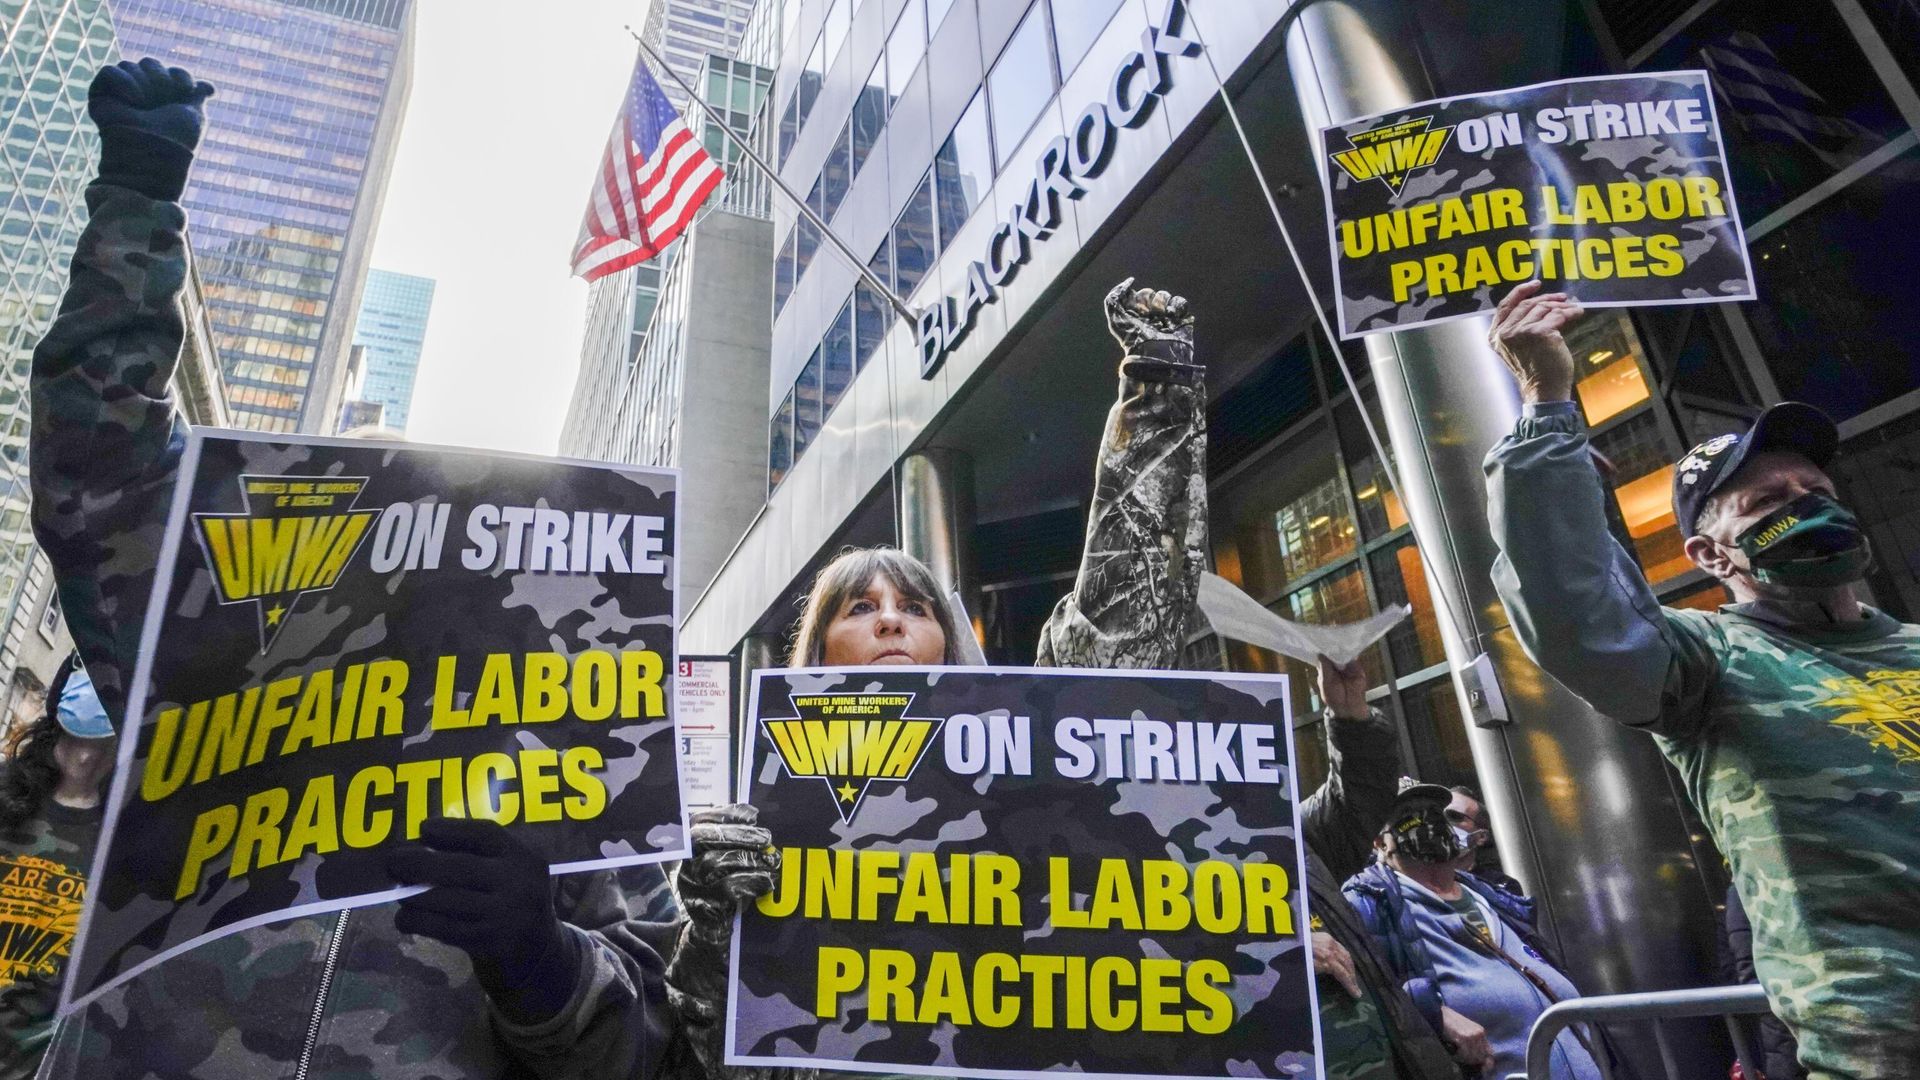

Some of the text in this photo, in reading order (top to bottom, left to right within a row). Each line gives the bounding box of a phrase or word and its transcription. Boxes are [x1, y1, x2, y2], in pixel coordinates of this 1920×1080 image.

[1335, 128, 1448, 180] UMWA
[1457, 99, 1707, 153] ON STRIKE
[916, 0, 1208, 381] BLACKROCK
[1341, 176, 1726, 259] UNFAIR LABOR
[1390, 234, 1685, 303] PRACTICES
[203, 513, 373, 600] UMWA
[370, 502, 665, 574] ON STRIKE
[1755, 515, 1799, 547] UMWA
[143, 649, 665, 802] UNFAIR LABOR
[796, 697, 908, 706] UNITED MINE WORKERS
[822, 705, 880, 714] OF AMERICA
[768, 719, 932, 777] UMWA
[944, 713, 1280, 784] ON STRIKE
[175, 745, 607, 900] PRACTICES
[2, 867, 50, 889] ARE
[756, 846, 1294, 936] UNFAIR LABOR
[816, 945, 1235, 1036] PRACTICES
